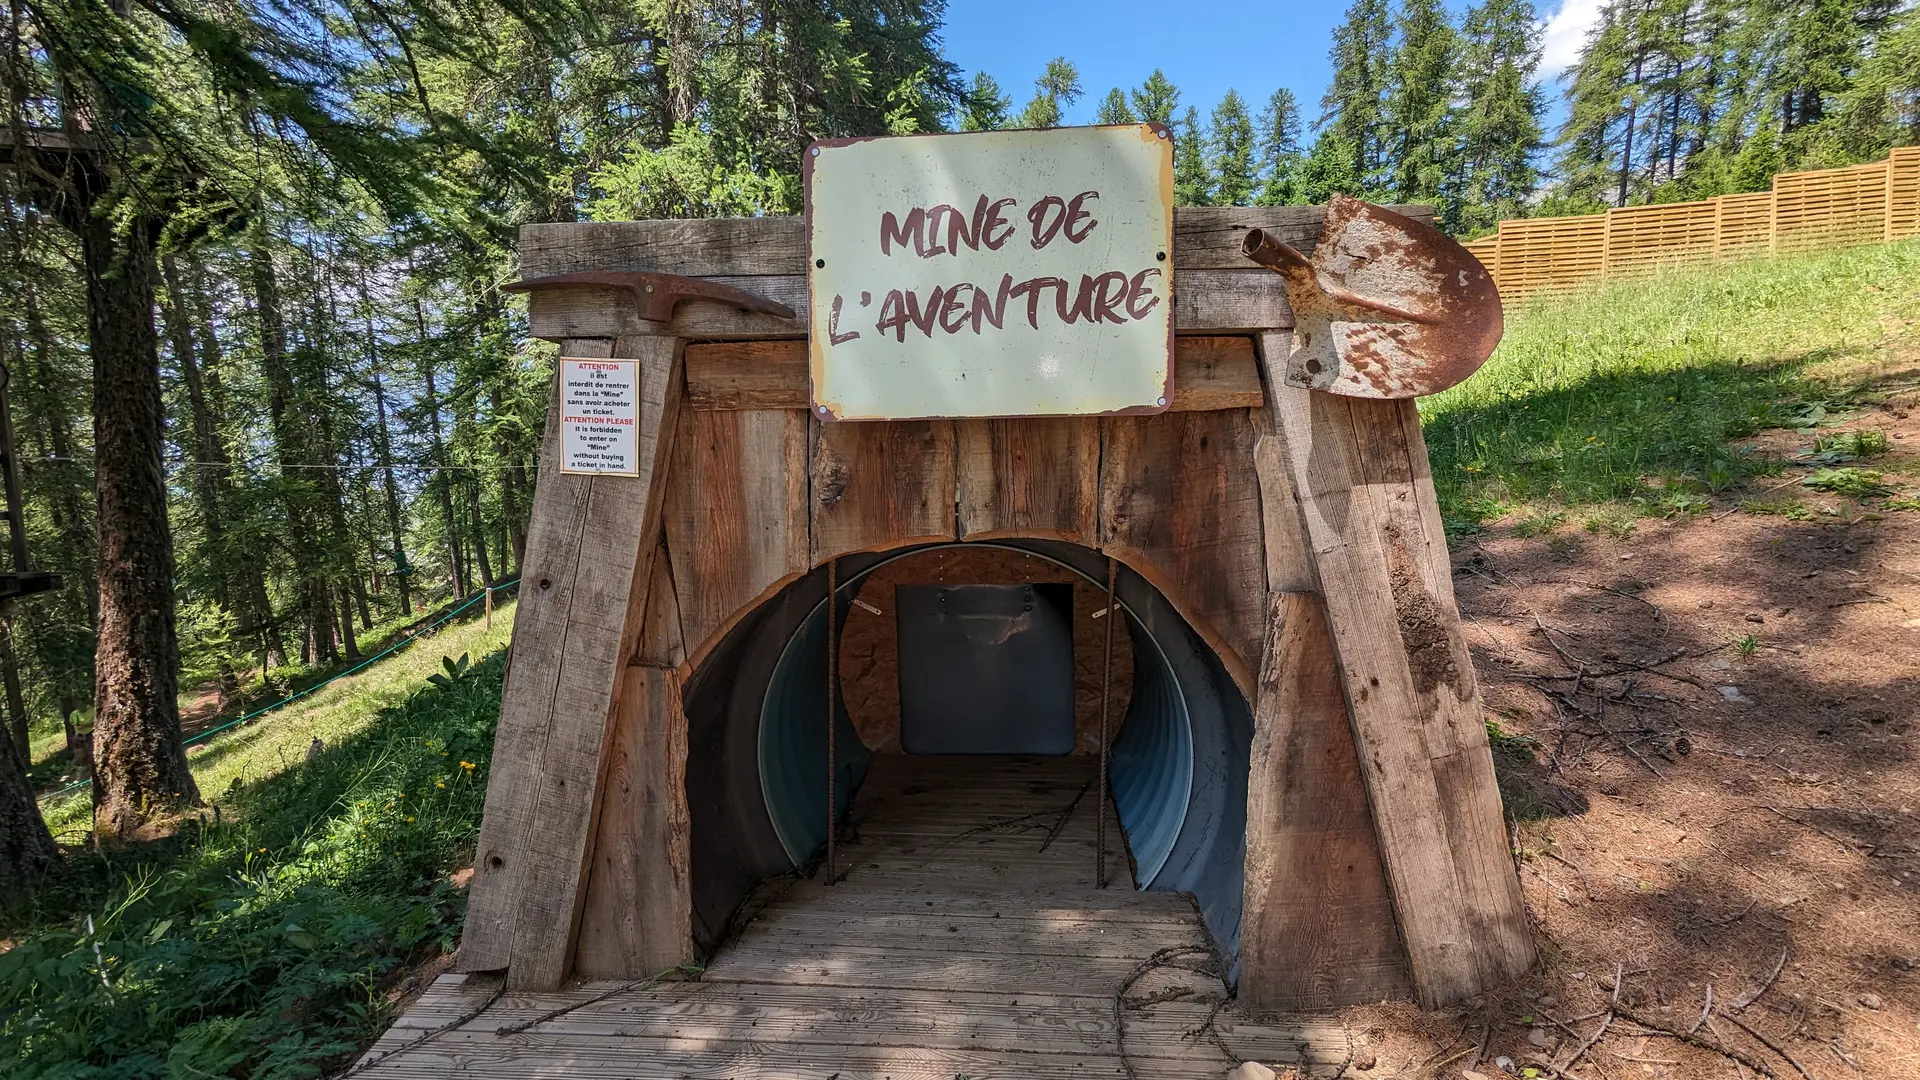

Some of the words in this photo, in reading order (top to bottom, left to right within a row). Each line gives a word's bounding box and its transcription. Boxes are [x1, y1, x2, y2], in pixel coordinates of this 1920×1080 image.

[880, 193, 1017, 259] MINE
[1027, 191, 1099, 250] DE
[828, 268, 1162, 346] L'AVENTURE
